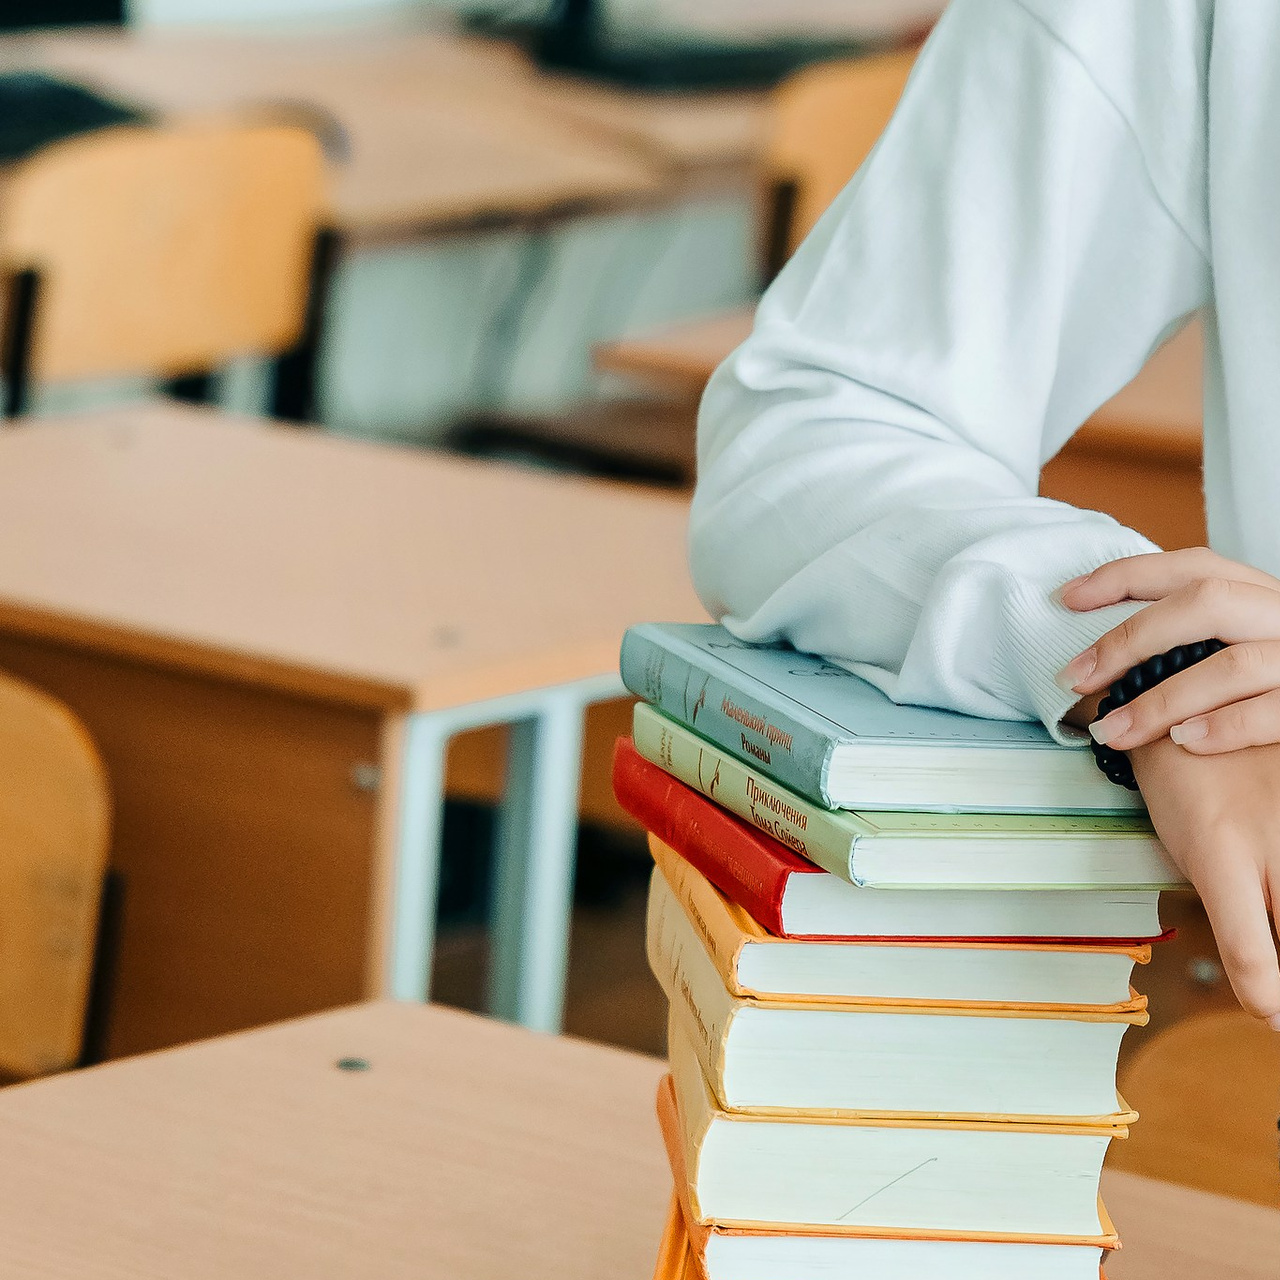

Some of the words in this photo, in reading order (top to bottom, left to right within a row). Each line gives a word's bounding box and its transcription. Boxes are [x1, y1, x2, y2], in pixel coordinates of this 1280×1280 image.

[720, 697, 767, 735] Маленький
[766, 724, 794, 755] принц
[741, 732, 771, 765] Романы
[746, 776, 808, 831] Приключения
[749, 805, 774, 835] Тома
[774, 821, 809, 857] Сойера
